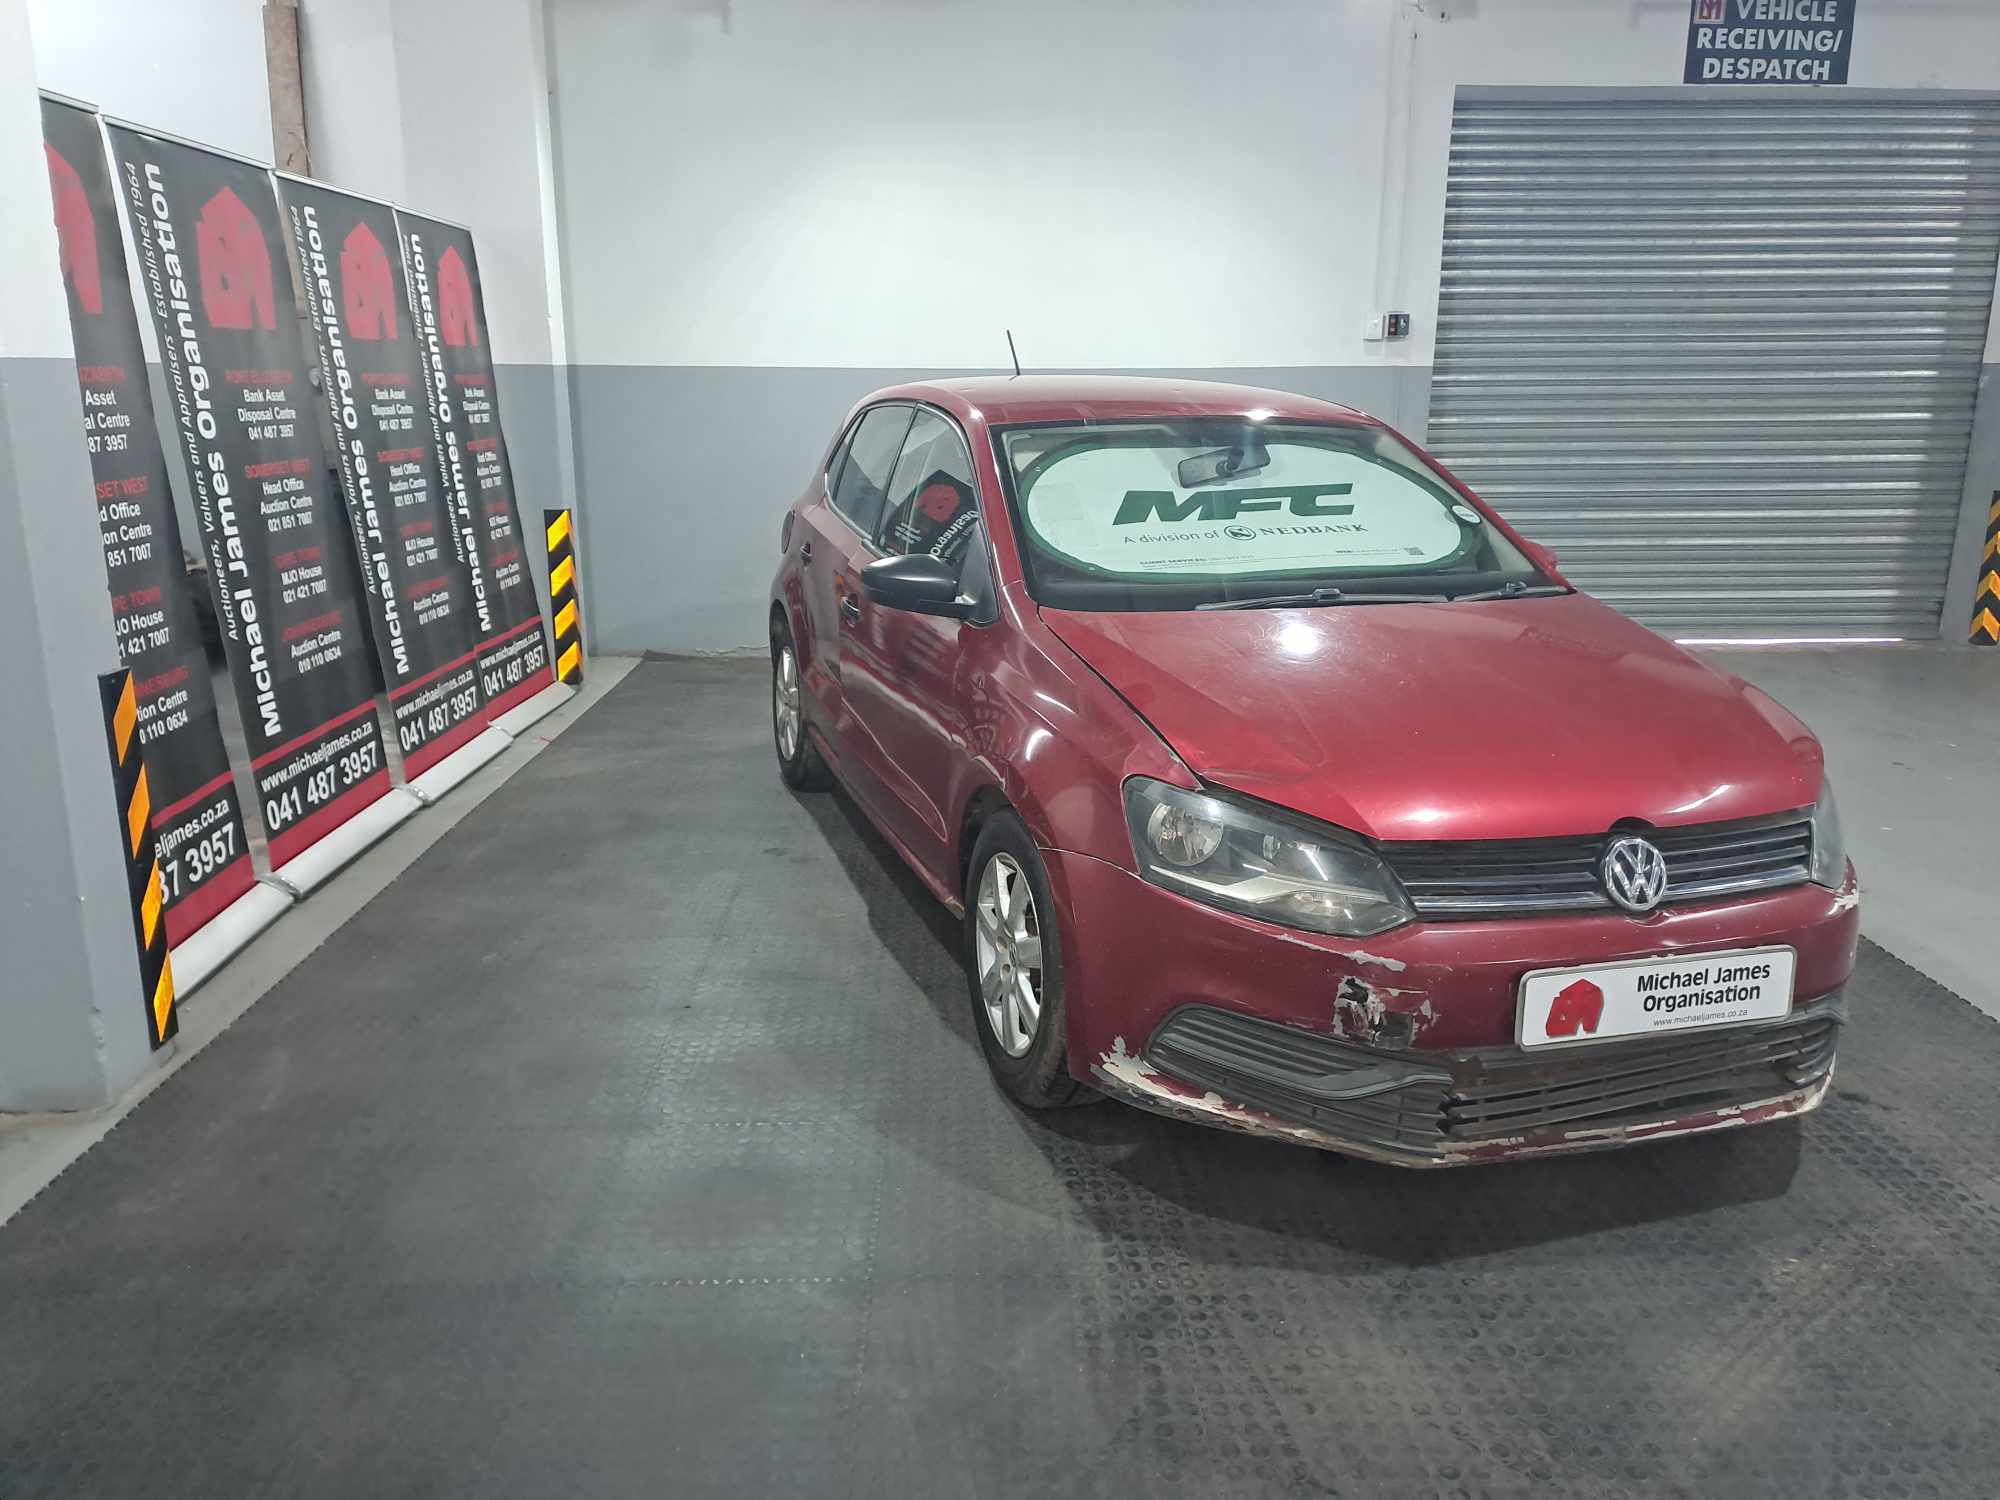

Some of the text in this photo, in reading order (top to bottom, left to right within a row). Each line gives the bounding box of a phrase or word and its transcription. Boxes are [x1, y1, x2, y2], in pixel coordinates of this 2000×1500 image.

[1737, 0, 1838, 22] VEHICLE
[1697, 28, 1843, 52] RECEIVING/
[1702, 58, 1831, 80] DESPATCH
[124, 161, 144, 208] 1964
[136, 214, 169, 319] Established
[164, 335, 192, 427] Appraisers
[85, 389, 117, 406] Asset
[97, 411, 131, 429] Centre
[237, 407, 274, 424] Disposal
[104, 433, 128, 452] 3957
[303, 205, 410, 675] Michael James Organisation
[411, 233, 492, 631] Michael James Organisation
[145, 162, 282, 737] Michael James Organisation
[184, 432, 200, 464] and
[109, 501, 141, 520] Office
[194, 471, 215, 532] Valuers
[1112, 483, 1355, 525] MFC
[120, 522, 153, 541] Centre
[1123, 530, 1220, 545] A division of
[1259, 523, 1369, 536] NEDBANK
[108, 542, 152, 567] 851 7007
[210, 538, 239, 641] Auctioneers,
[130, 609, 164, 631] House
[128, 634, 146, 655] 421
[148, 626, 170, 649] 7007
[484, 645, 544, 696] 041 487 3957
[158, 689, 189, 713] Centre
[147, 719, 165, 740] 110
[167, 709, 189, 735] 0634
[400, 686, 478, 751] 041 487 3957
[260, 721, 374, 793] www.michaeljames.co.za
[266, 741, 378, 830] 041 487 3957
[185, 821, 235, 882] 3957
[1637, 963, 1771, 993] Michael James
[1643, 985, 1761, 1013] Organisation
[1653, 1008, 1749, 1027] www.michaeljames.co.za
